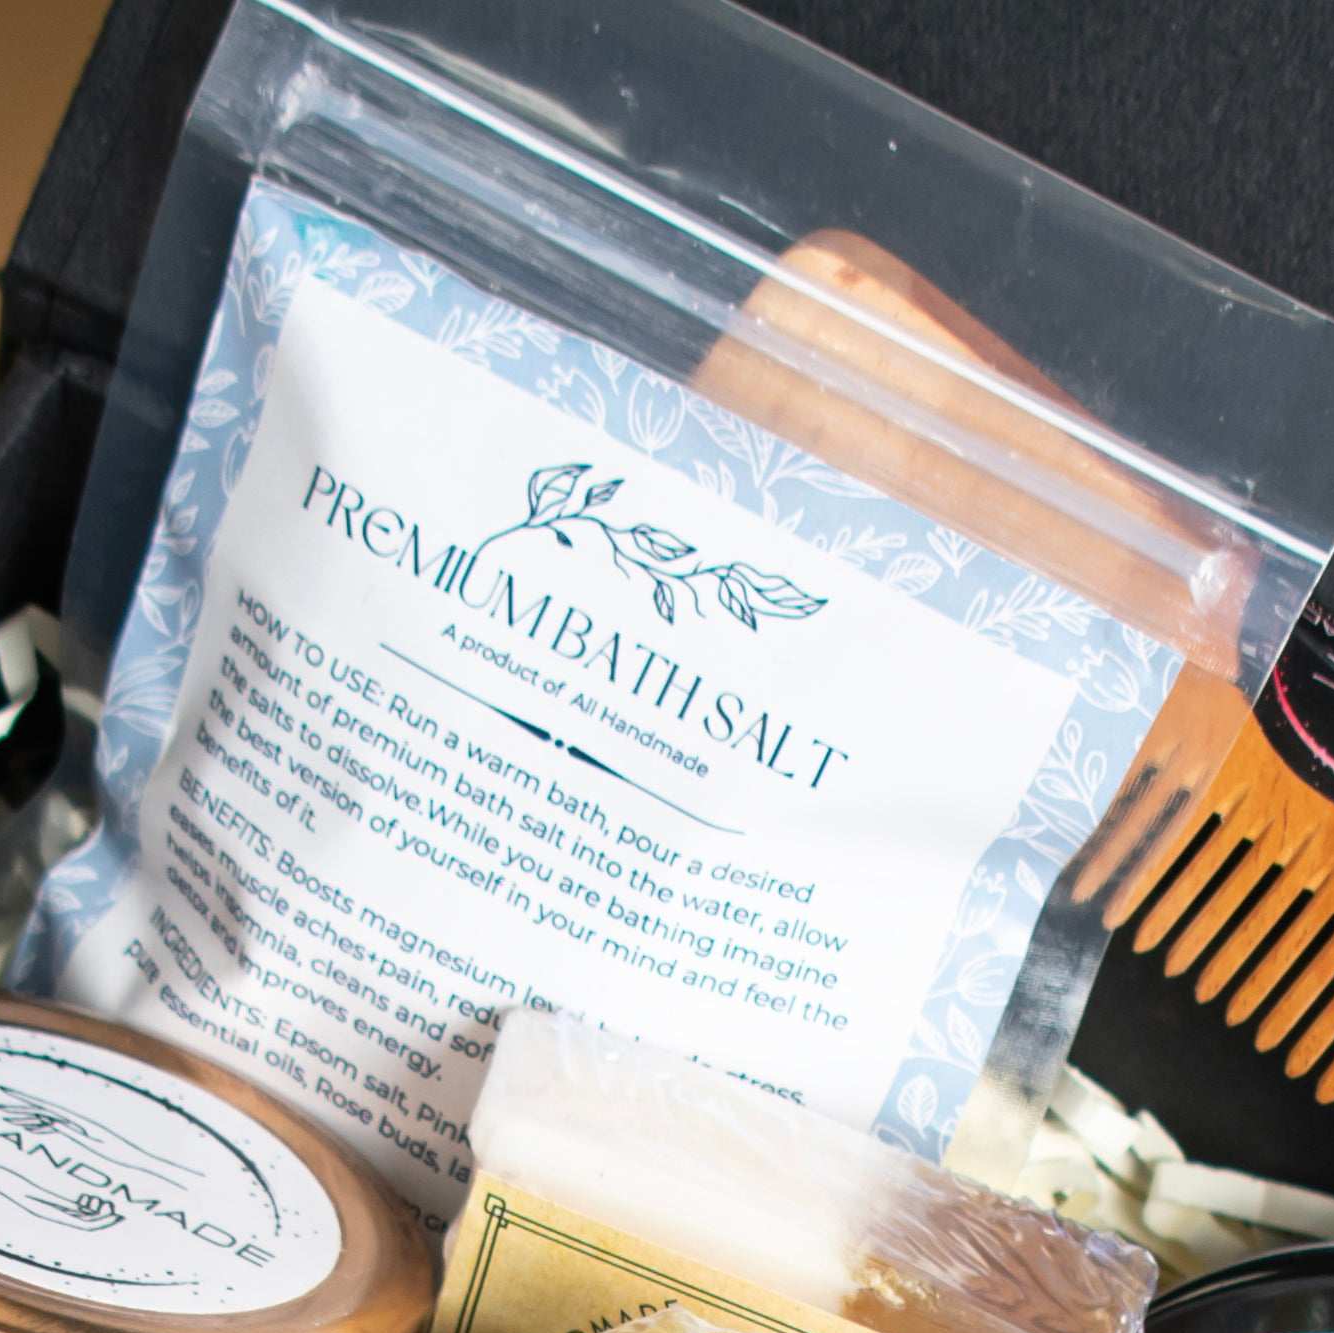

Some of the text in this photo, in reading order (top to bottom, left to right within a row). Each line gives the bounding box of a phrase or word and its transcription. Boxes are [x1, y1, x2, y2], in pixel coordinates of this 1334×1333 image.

[237, 588, 816, 905] HOW TO USE: Run warm bath, pour desired
[303, 465, 849, 788] PREMIUM BATH SALT
[462, 634, 709, 779] product of All Handmade
[195, 718, 302, 815] benefits of
[208, 687, 850, 1034] the best version of yourself in your mind and feel the
[220, 655, 839, 991] the salts to you are bathing imagine
[229, 624, 849, 953] amount of premium bath salt into the water, allow
[275, 849, 517, 1002] Boosts magnesium
[157, 981, 440, 1174] essential oils, Rose buds,
[273, 1017, 410, 1118] Epsom salt,
